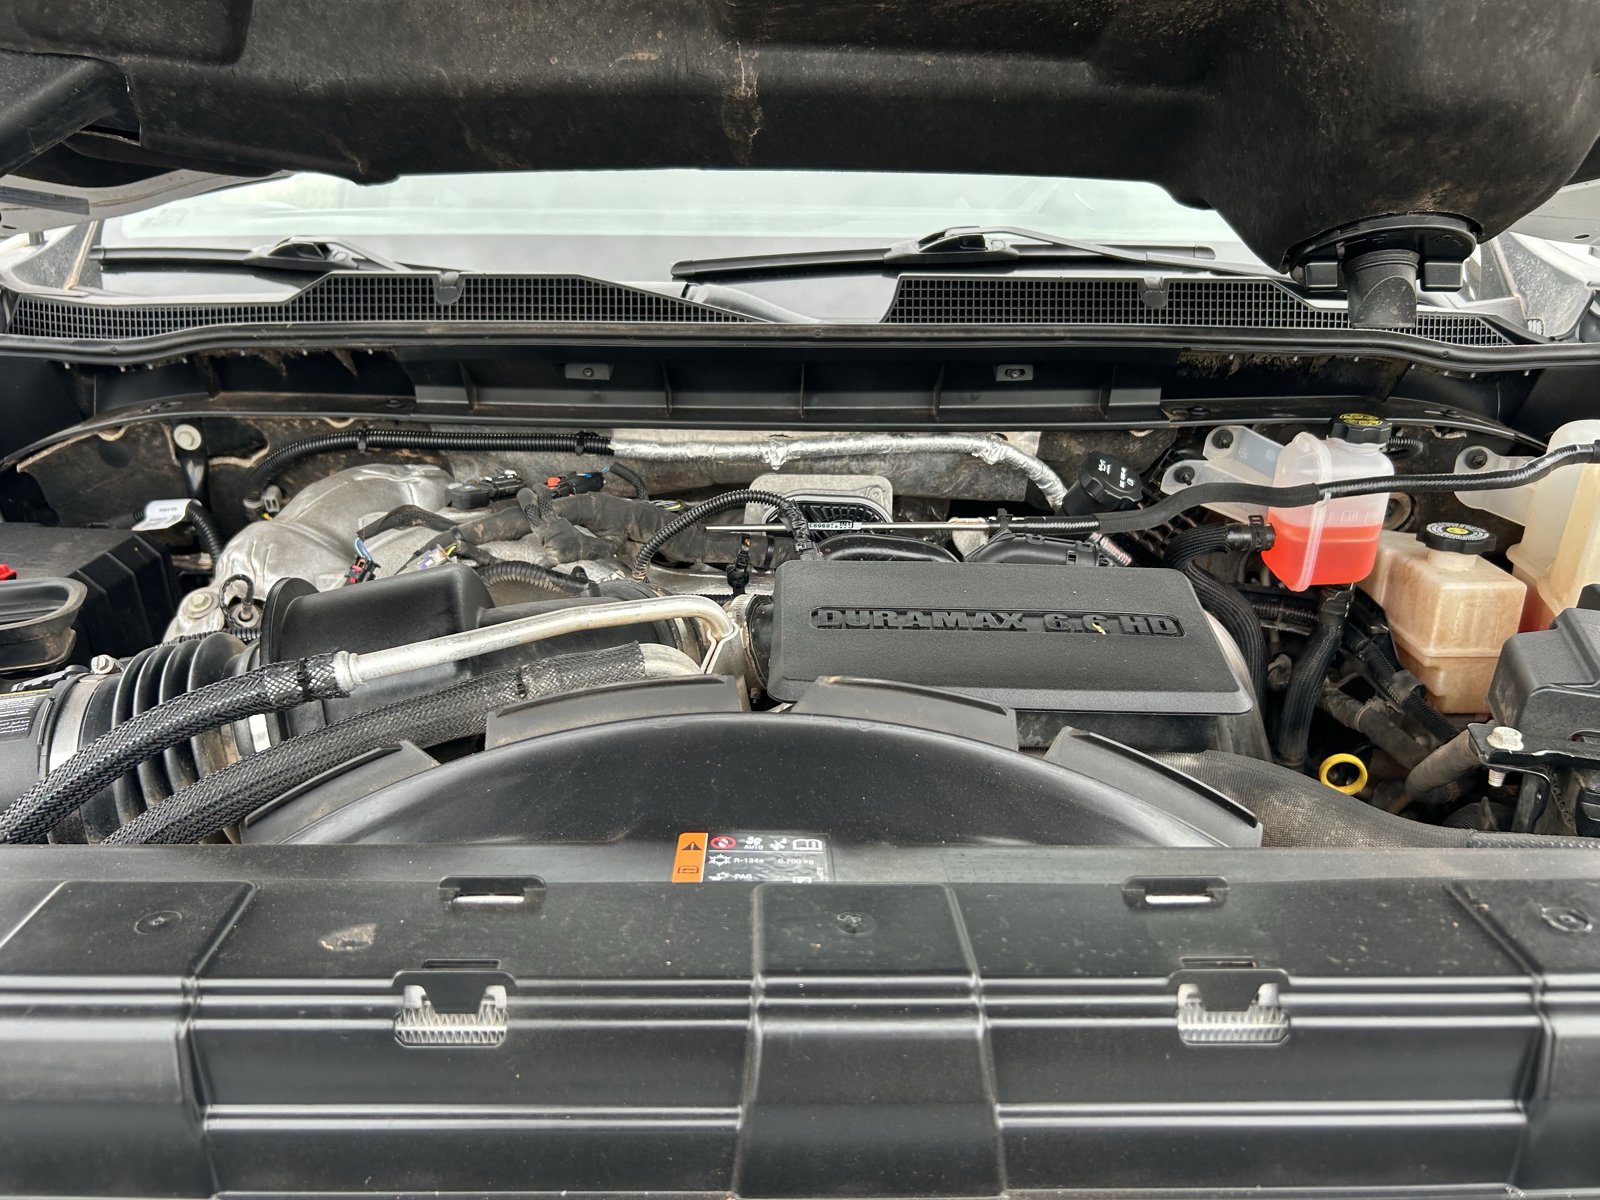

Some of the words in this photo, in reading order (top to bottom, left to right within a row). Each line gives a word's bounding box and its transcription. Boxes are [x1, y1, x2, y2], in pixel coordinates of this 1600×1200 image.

[816, 609, 1027, 630] DURAMAX
[1043, 613, 1106, 634] 6.6
[1120, 615, 1179, 636] HD
